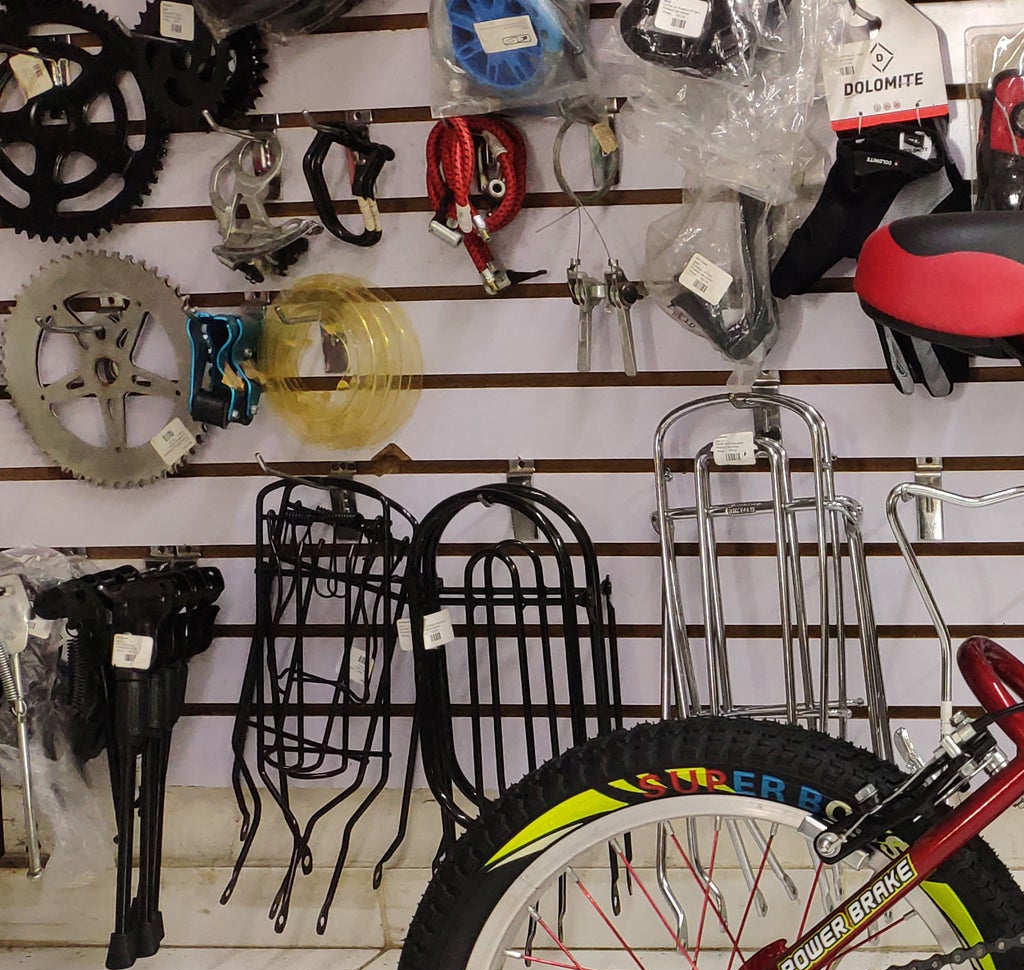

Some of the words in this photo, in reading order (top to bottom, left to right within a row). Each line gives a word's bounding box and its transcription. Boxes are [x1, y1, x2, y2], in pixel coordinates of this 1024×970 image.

[844, 72, 924, 96] DOLOMITE
[639, 769, 785, 801] SUPER
[847, 858, 916, 928] BRAKE
